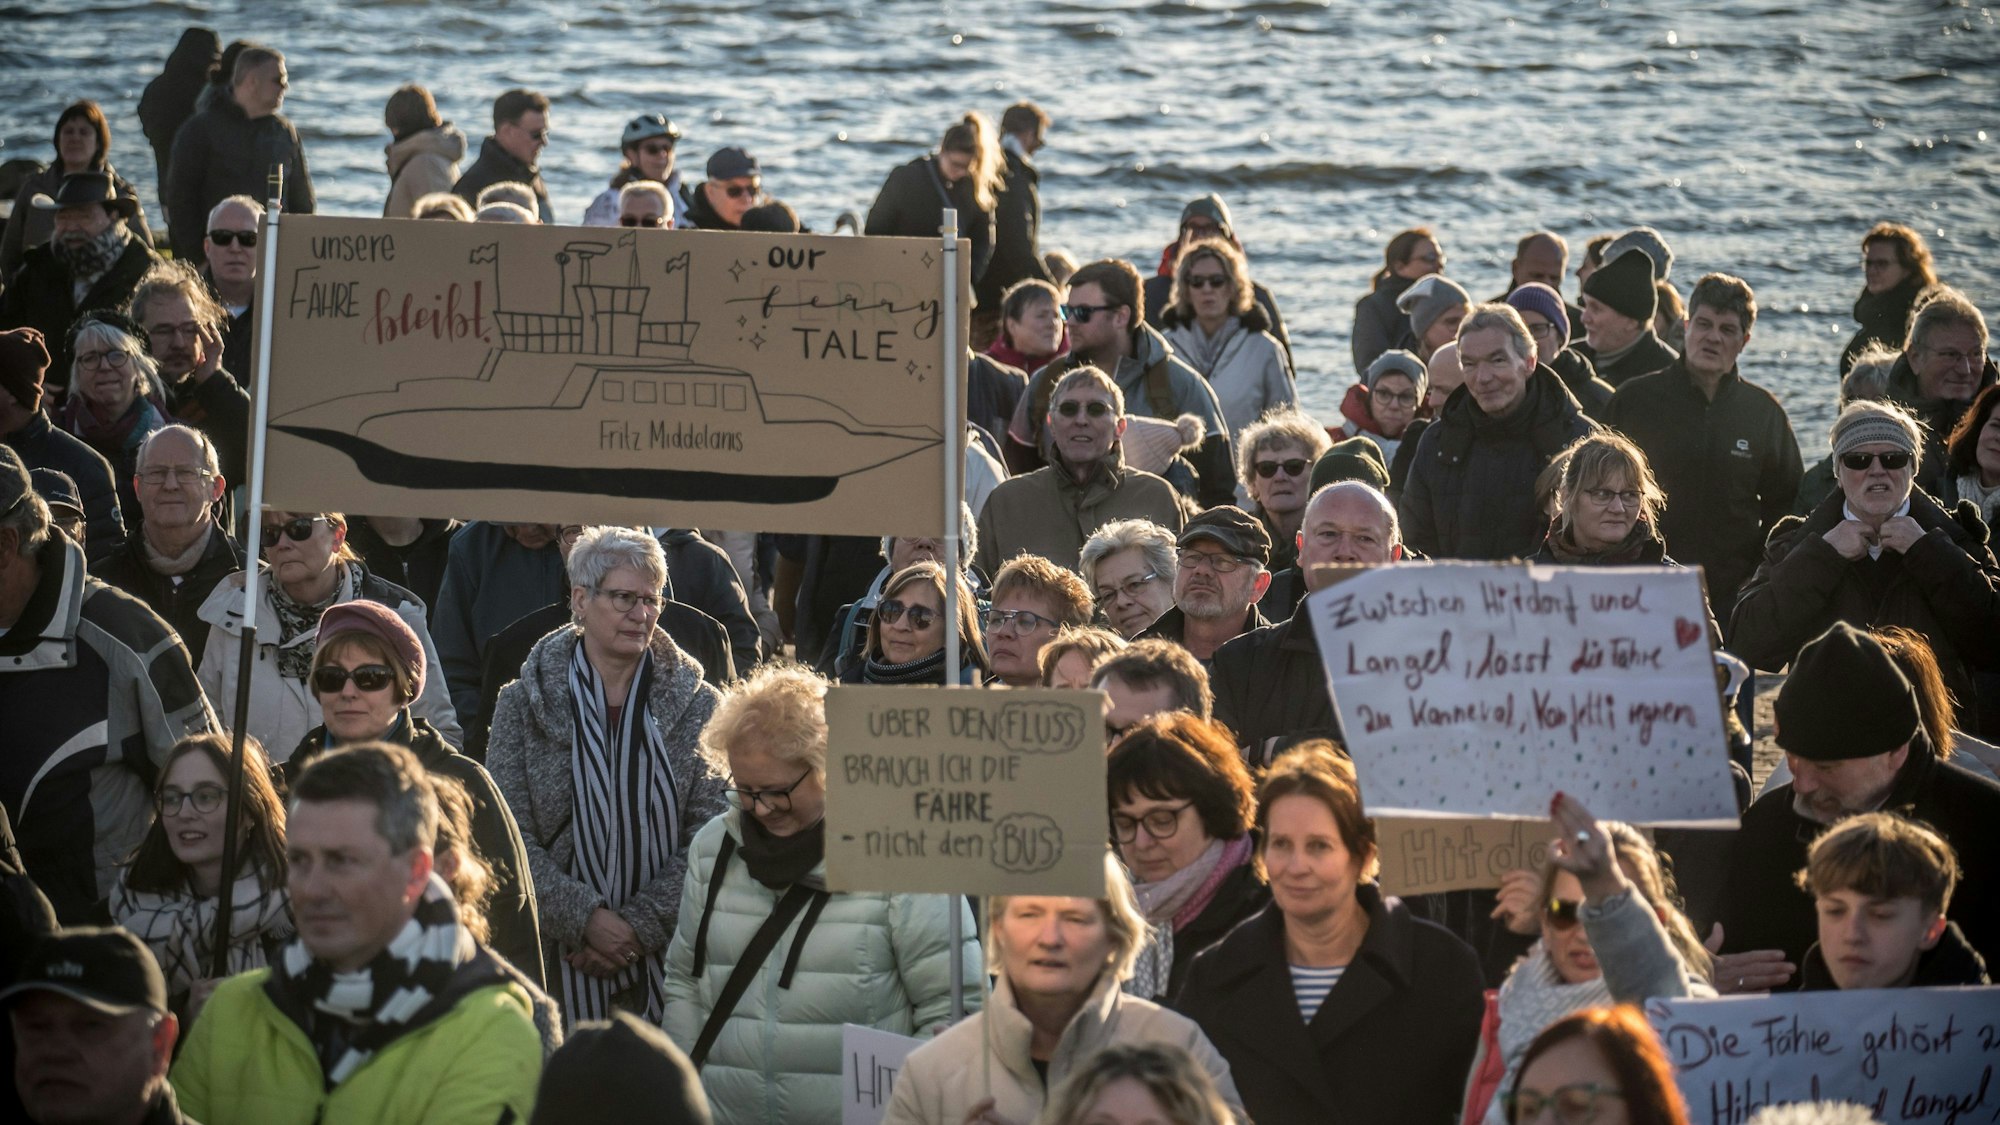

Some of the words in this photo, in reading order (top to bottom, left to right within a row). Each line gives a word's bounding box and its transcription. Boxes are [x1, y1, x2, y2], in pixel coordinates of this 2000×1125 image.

[312, 234, 395, 263] unsere
[768, 246, 826, 270] our
[290, 266, 360, 319] FÄHRE
[725, 285, 944, 340] ferry
[792, 327, 898, 361] TALE
[600, 420, 642, 450] Fritz
[650, 420, 743, 452] Middelanis
[1327, 585, 1465, 629] Zwischen
[1591, 583, 1649, 614] und
[948, 706, 999, 741] DEN
[1006, 709, 1078, 746] FLUSS
[844, 754, 929, 787] BRAUCH
[939, 753, 972, 784] ICH
[981, 754, 1021, 783] DIE
[914, 787, 994, 823] FÄHRE
[865, 827, 927, 858] nicht
[939, 830, 984, 858] den
[1002, 824, 1055, 866] BUS
[1667, 1022, 1749, 1071] Die
[1752, 1013, 1844, 1058] Fähre
[1861, 1011, 1964, 1080] gehört
[1977, 1023, 2000, 1052] z
